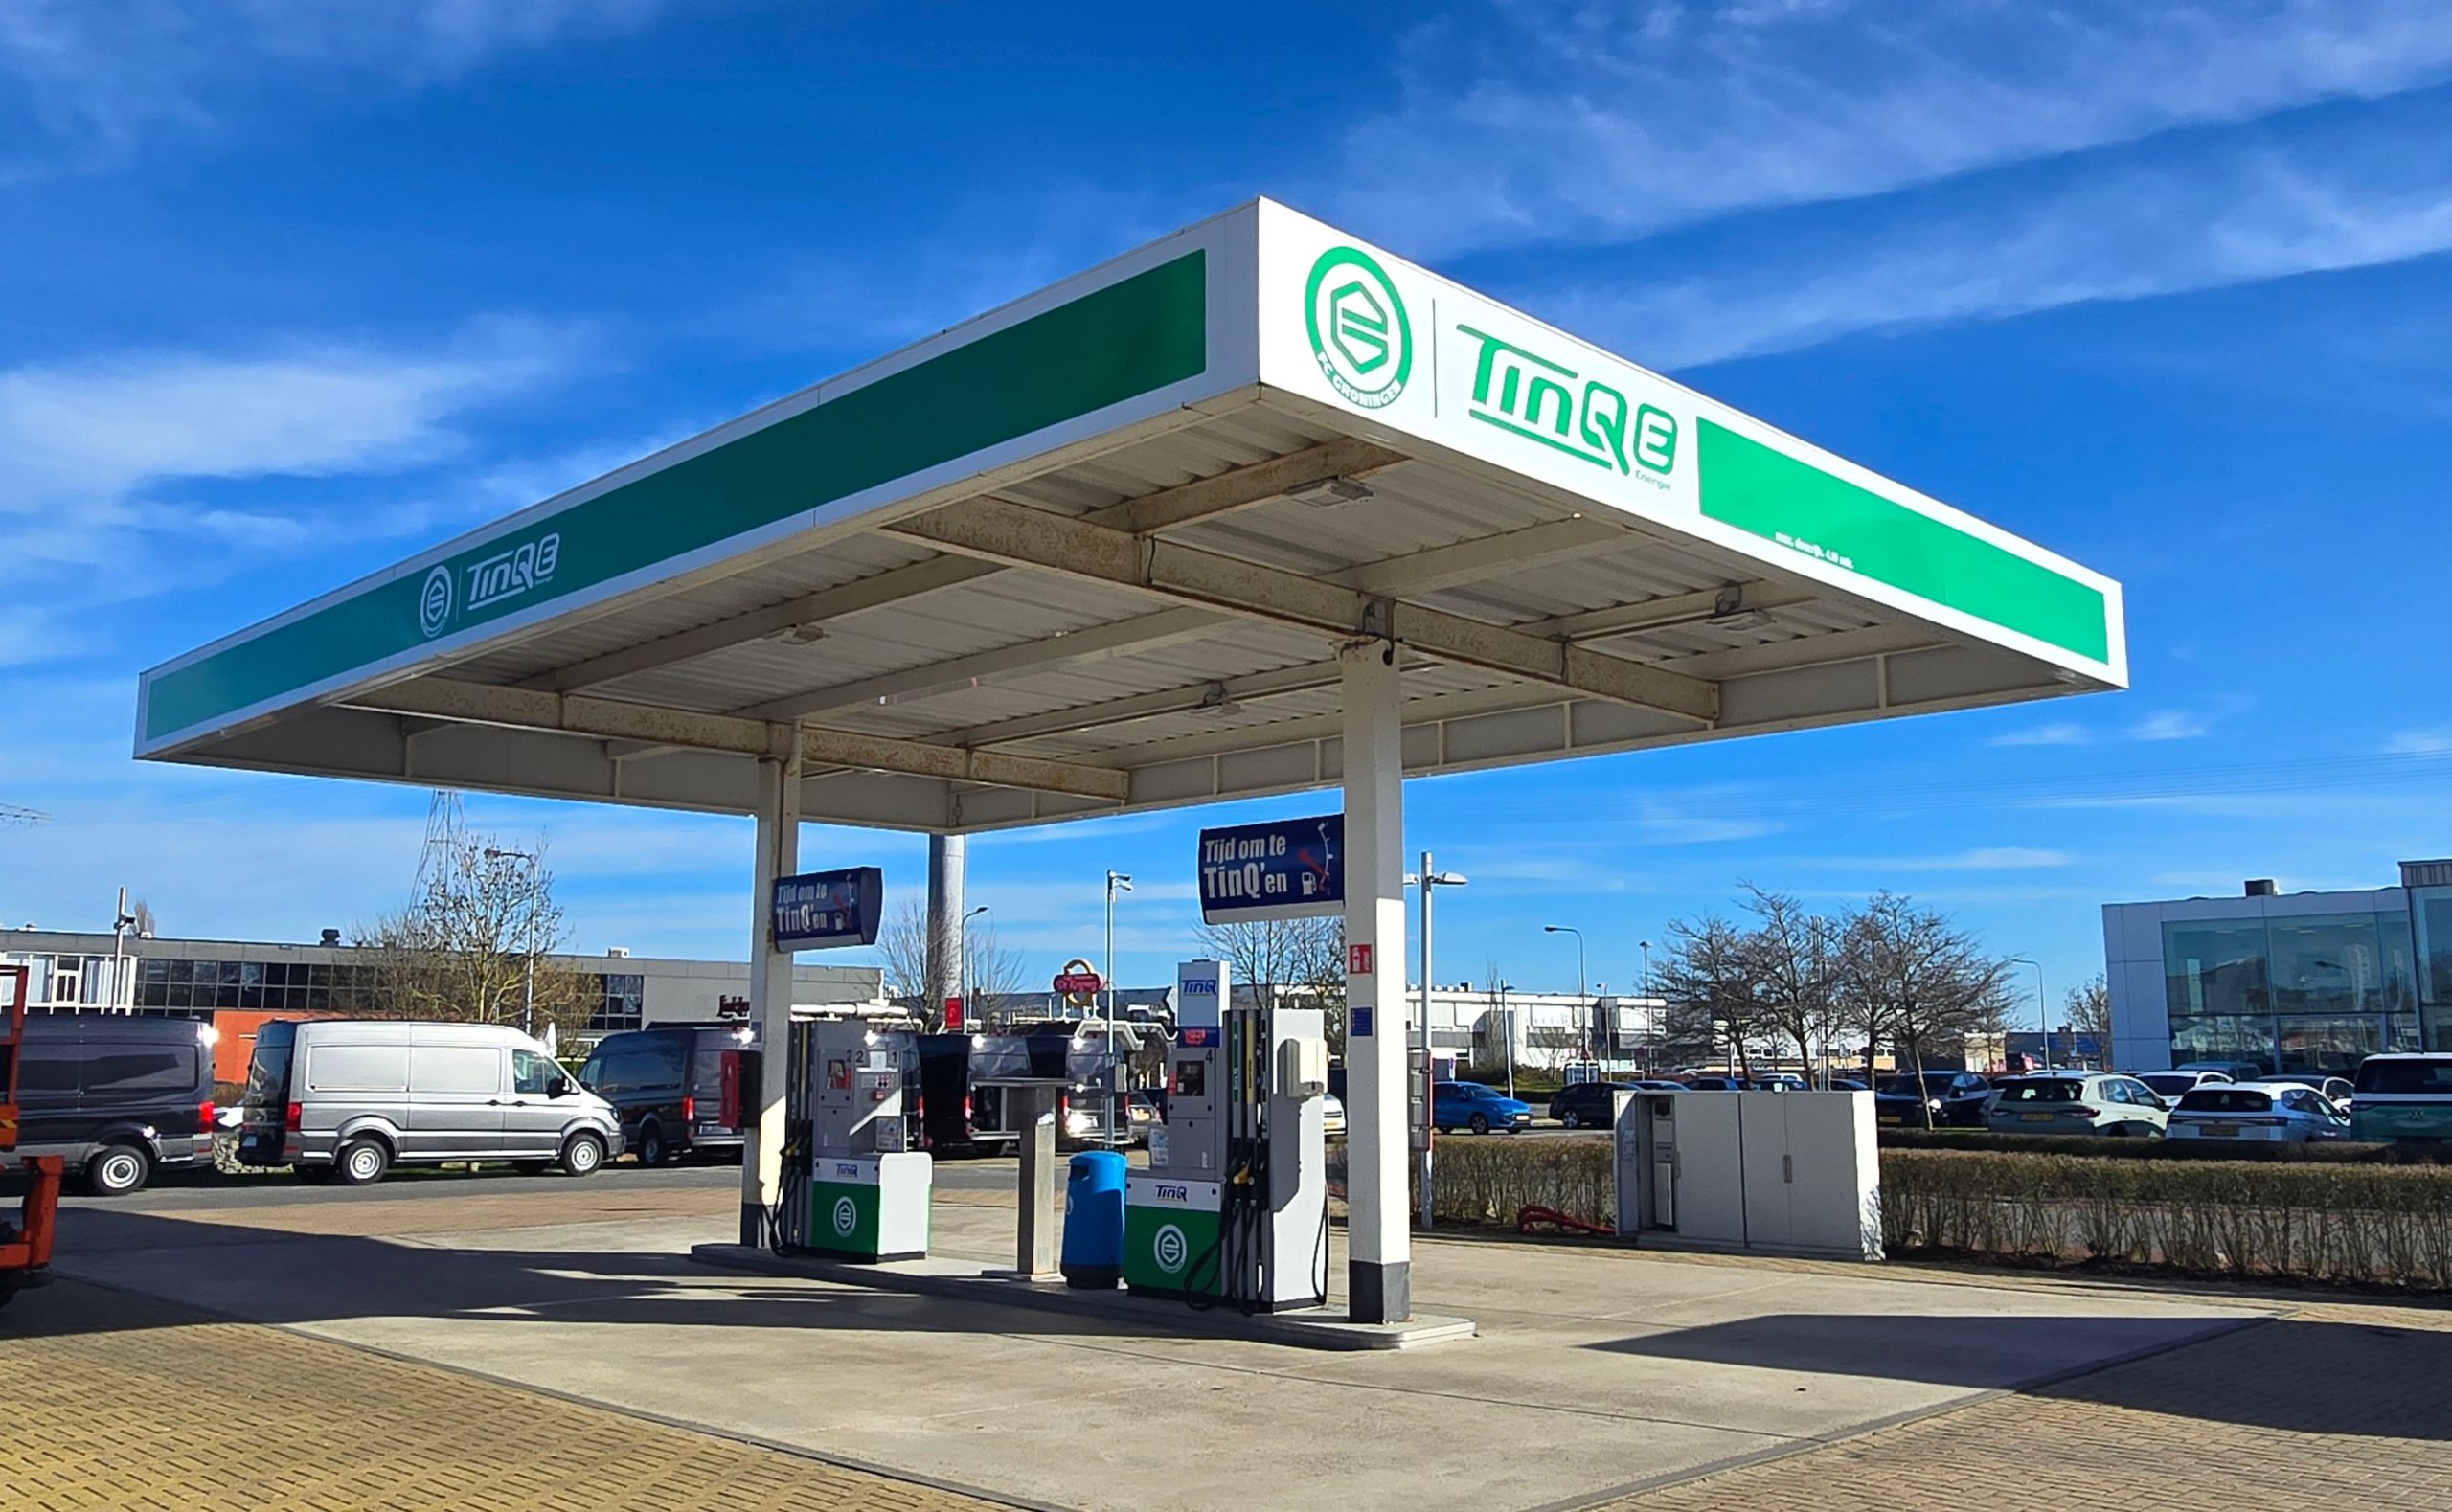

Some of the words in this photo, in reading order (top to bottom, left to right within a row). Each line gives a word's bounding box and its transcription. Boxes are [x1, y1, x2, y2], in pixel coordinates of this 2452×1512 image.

[1205, 837, 1237, 864] Tijd
[1238, 838, 1265, 860] om
[1269, 835, 1286, 856] te
[778, 885, 797, 904] Tijd
[798, 886, 815, 902] om
[816, 882, 828, 899] te
[1182, 979, 1217, 996] TinQ
[846, 1049, 852, 1063] 2
[855, 1050, 864, 1063] 2
[892, 1051, 897, 1063] 1
[1205, 1049, 1213, 1065] 4
[835, 1162, 858, 1179] TinQ
[1154, 1185, 1188, 1202] TinQ
